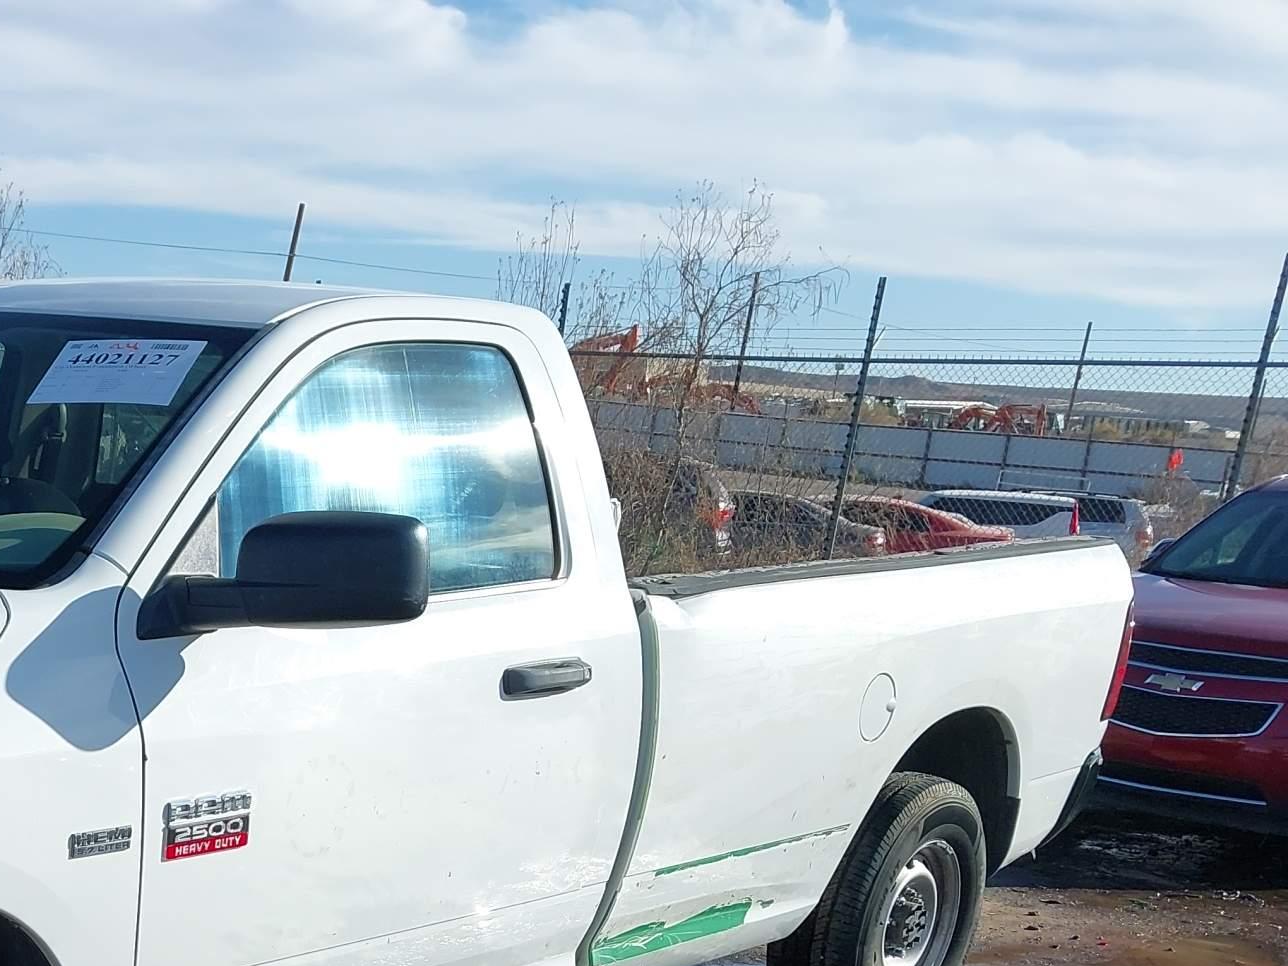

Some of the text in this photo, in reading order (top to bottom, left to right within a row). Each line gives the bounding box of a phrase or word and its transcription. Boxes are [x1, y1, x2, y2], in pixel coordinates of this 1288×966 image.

[68, 352, 180, 367] 44021127
[75, 825, 133, 847] HEMI
[175, 817, 244, 843] 2500
[97, 841, 130, 852] LITER
[175, 834, 242, 857] HEAVY DUTY
